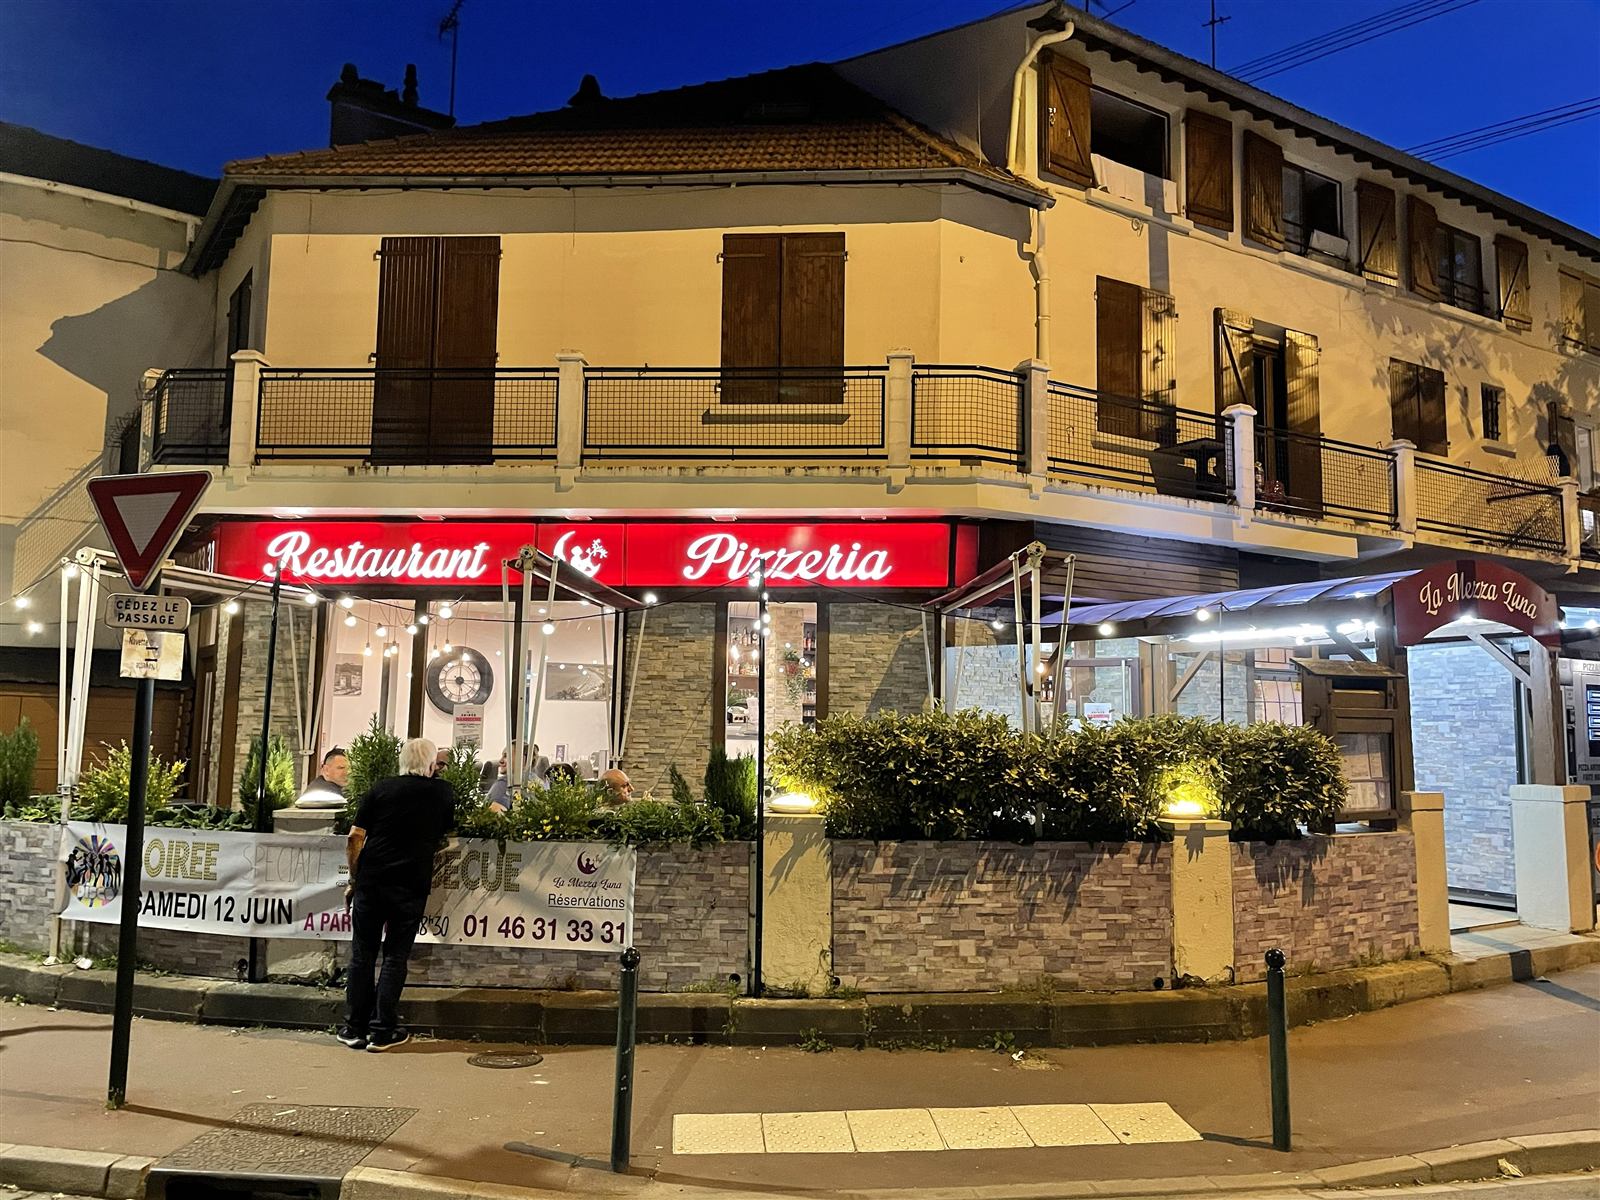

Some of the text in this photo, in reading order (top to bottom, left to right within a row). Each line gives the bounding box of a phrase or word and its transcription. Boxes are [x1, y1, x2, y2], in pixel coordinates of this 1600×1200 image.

[262, 530, 491, 579] Restaurant
[682, 532, 894, 580] Pizzeria
[116, 599, 179, 612] CÉDEZ LE
[1419, 571, 1538, 619] La Mezza Luna
[117, 613, 175, 625] PASSAGE
[143, 838, 220, 881] OIREE
[242, 844, 327, 885] SPECIALE
[553, 876, 622, 891] La Mezza Luna
[213, 894, 235, 922] 12
[240, 896, 294, 925] JUIN
[547, 893, 626, 908] Réservations
[303, 912, 315, 931] A
[463, 914, 626, 944] 01 46 31 33 31
